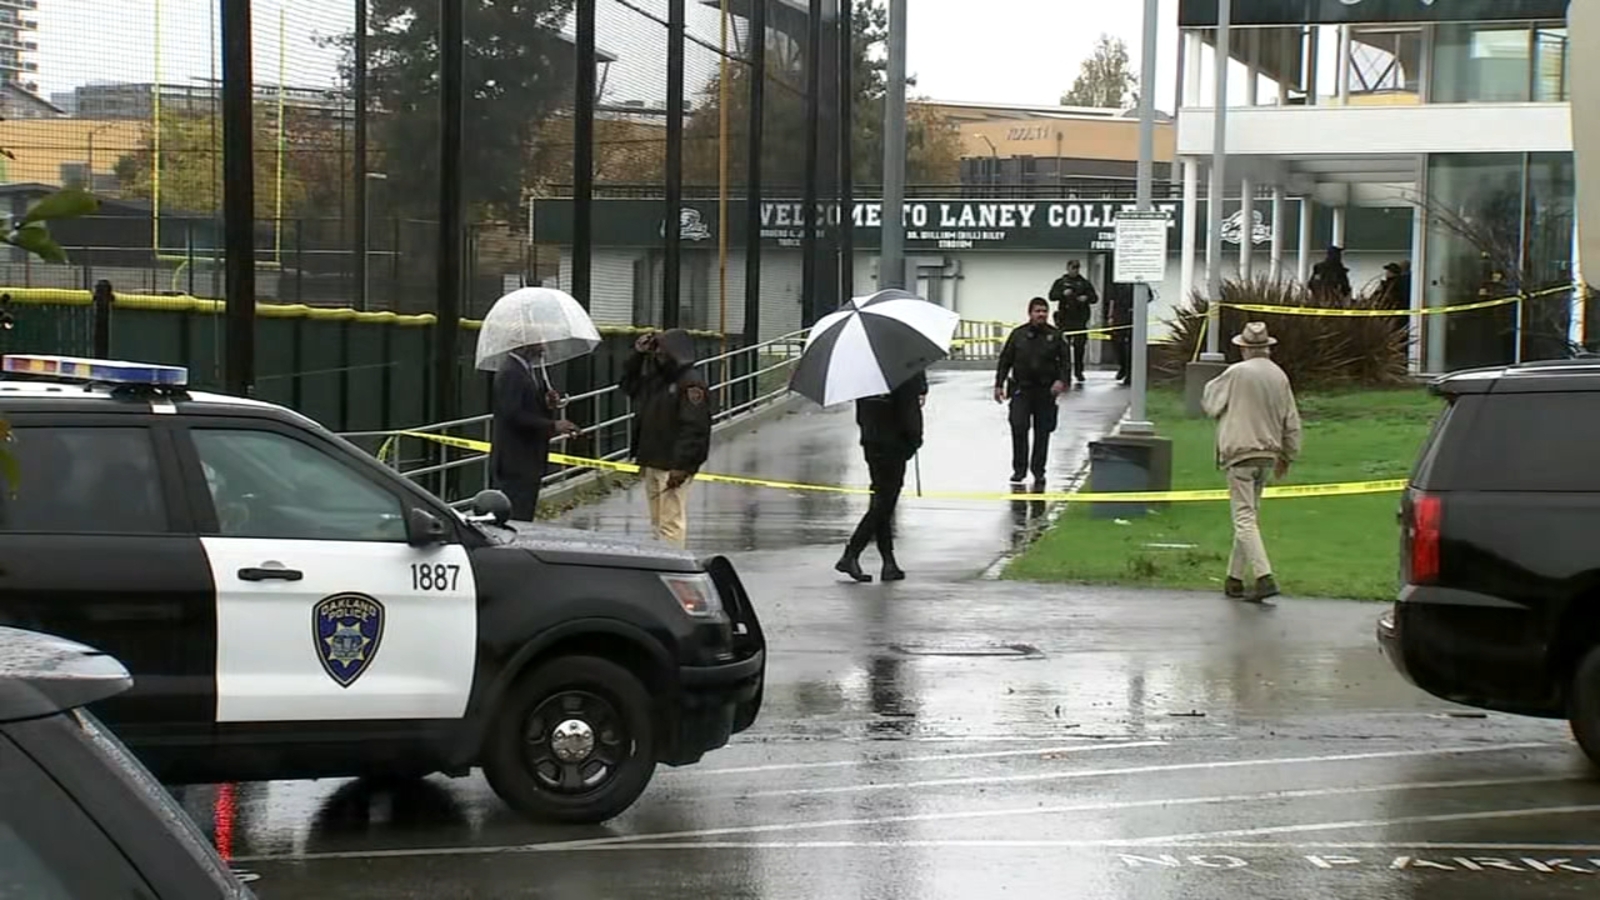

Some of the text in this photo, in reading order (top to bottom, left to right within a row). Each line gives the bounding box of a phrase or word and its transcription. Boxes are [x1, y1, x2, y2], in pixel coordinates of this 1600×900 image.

[939, 203, 1036, 227] LANEY
[1048, 203, 1176, 228] COLLE
[411, 562, 460, 591] 1887
[320, 599, 376, 616] OAKLAND
[328, 607, 369, 622] POLICE
[1116, 853, 1249, 868] NO
